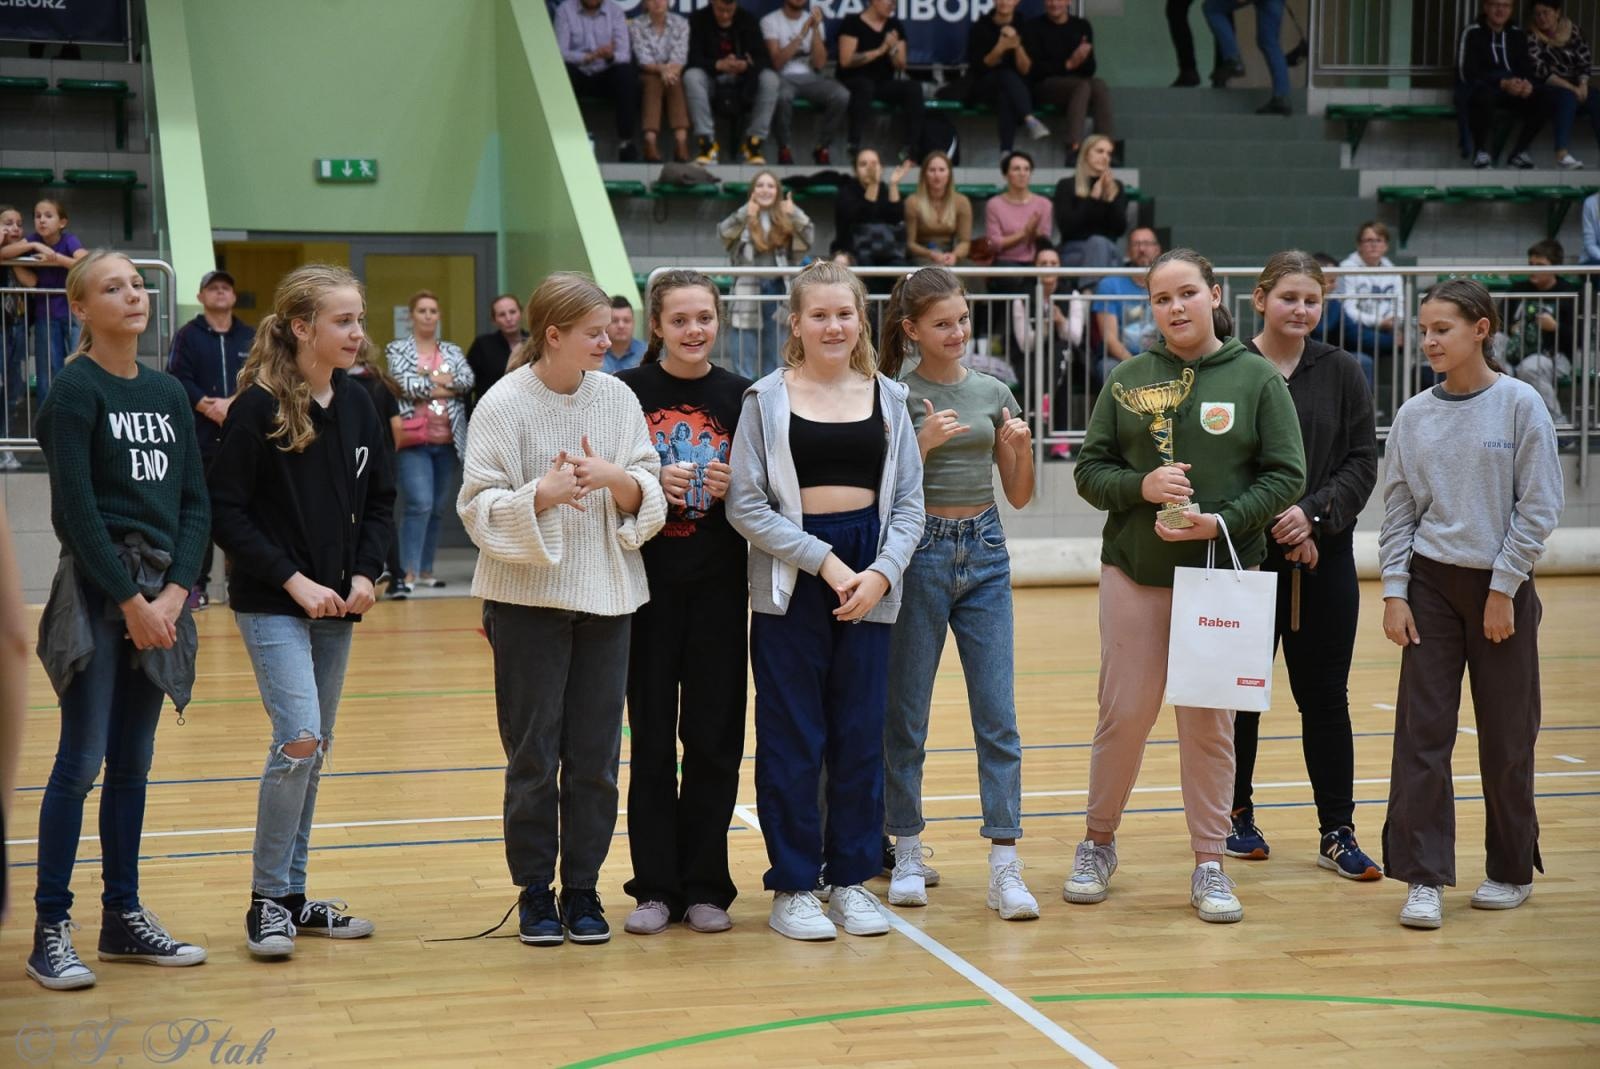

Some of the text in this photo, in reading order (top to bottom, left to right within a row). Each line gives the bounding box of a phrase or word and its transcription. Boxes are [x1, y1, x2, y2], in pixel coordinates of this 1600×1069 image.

[108, 411, 177, 444] WEEK
[128, 448, 169, 481] END
[1198, 616, 1241, 629] Raben
